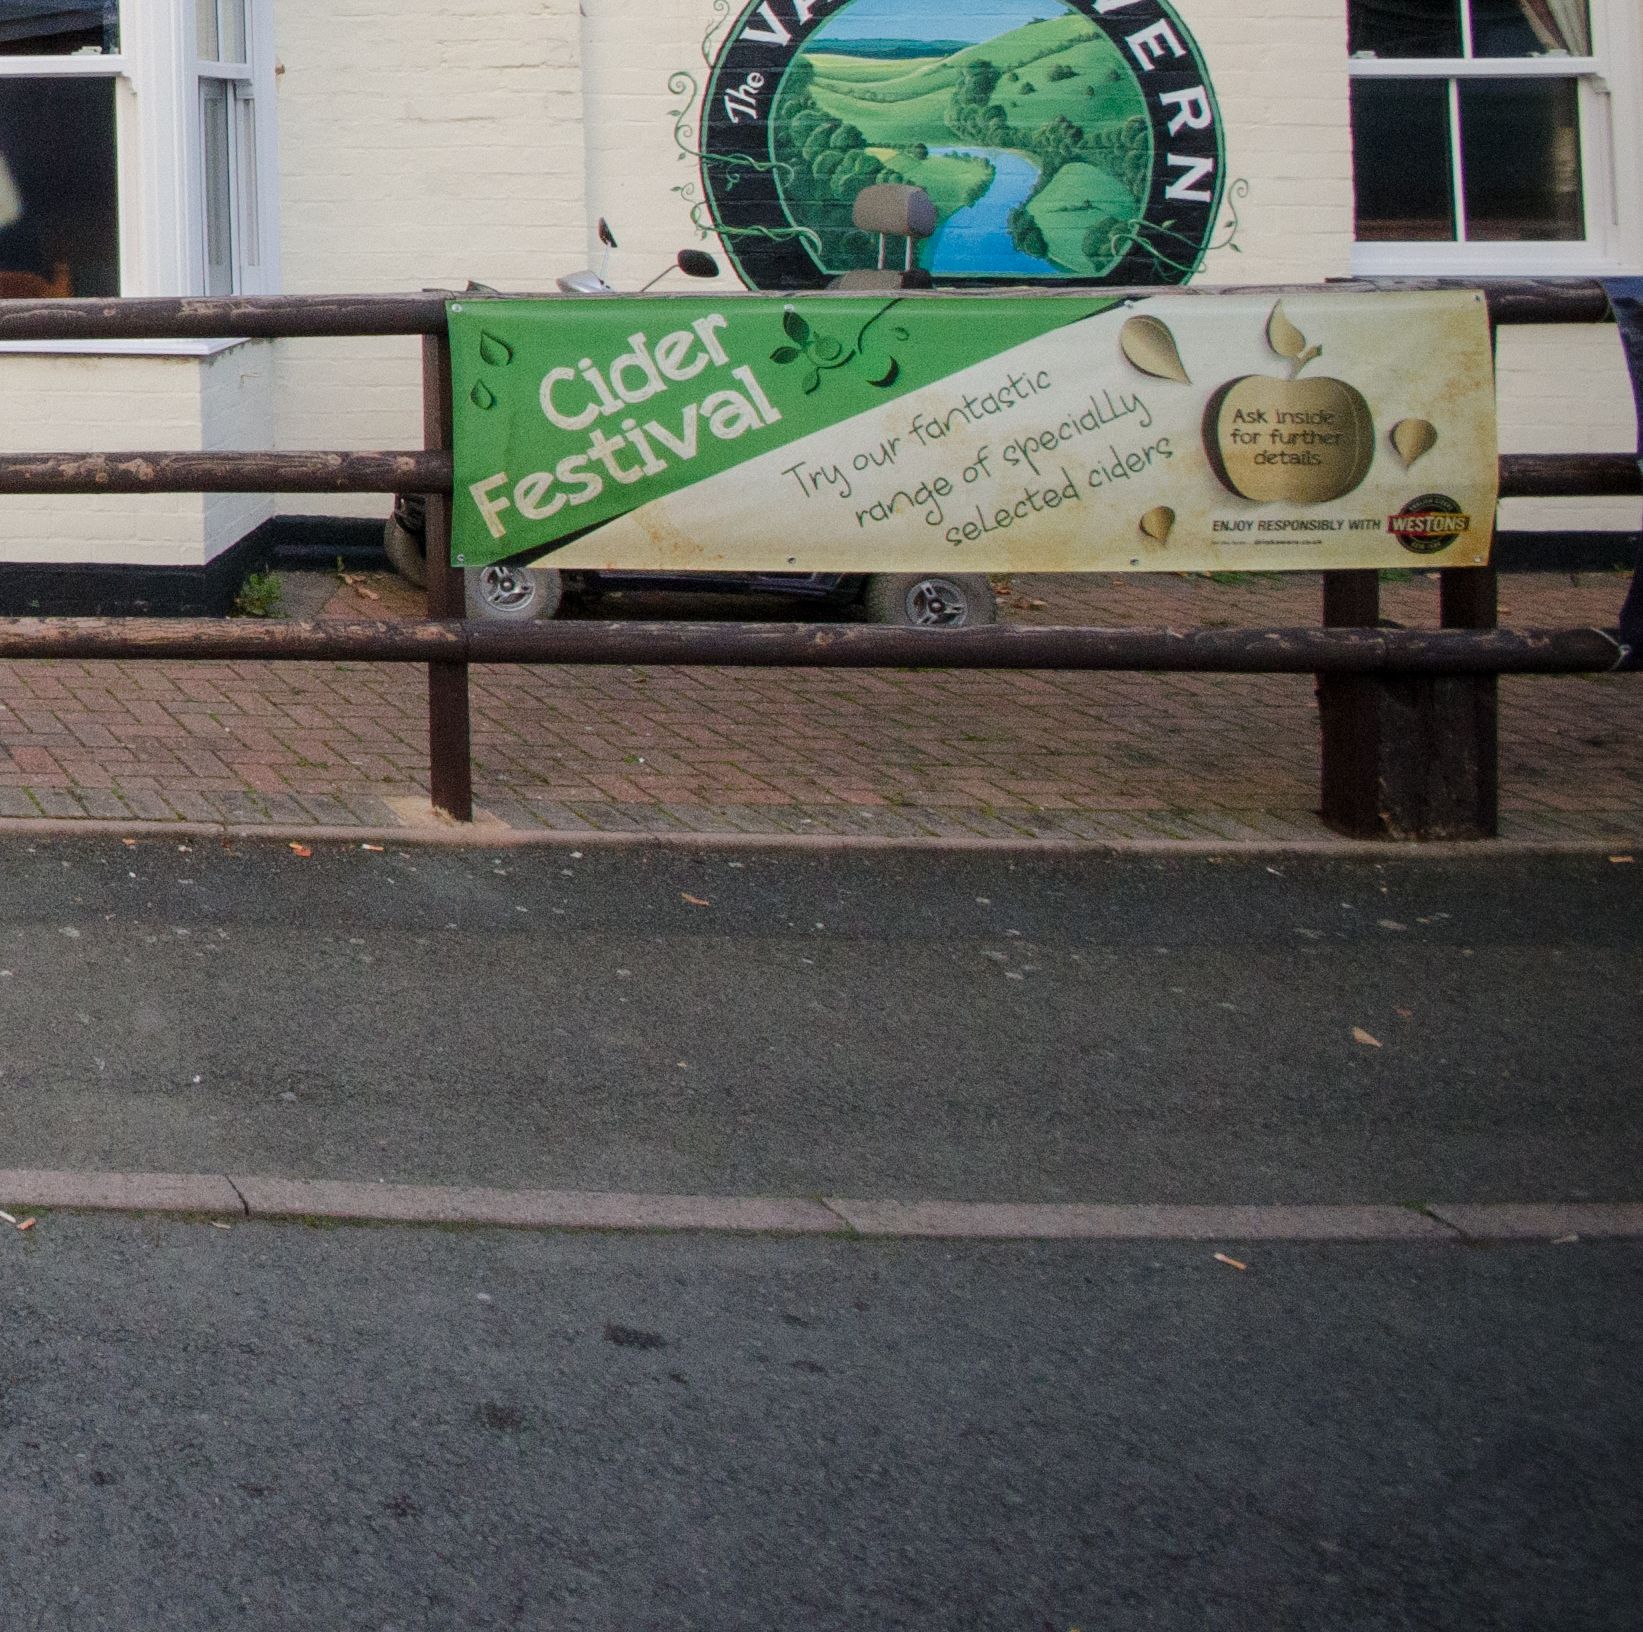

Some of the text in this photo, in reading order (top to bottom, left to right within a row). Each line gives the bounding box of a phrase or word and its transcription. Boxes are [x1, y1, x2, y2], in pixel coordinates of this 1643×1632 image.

[723, 71, 766, 125] The
[539, 313, 730, 431] Cider
[1232, 409, 1335, 424] Ask inside
[469, 365, 783, 538] Festival
[781, 370, 1051, 499] Try our fantastic
[855, 389, 1153, 527] range of specially
[1230, 429, 1343, 445] for further
[945, 436, 1174, 546] selected ciders
[1212, 516, 1466, 532] ENJOY RESPONSIBLY WITH WESTONS
